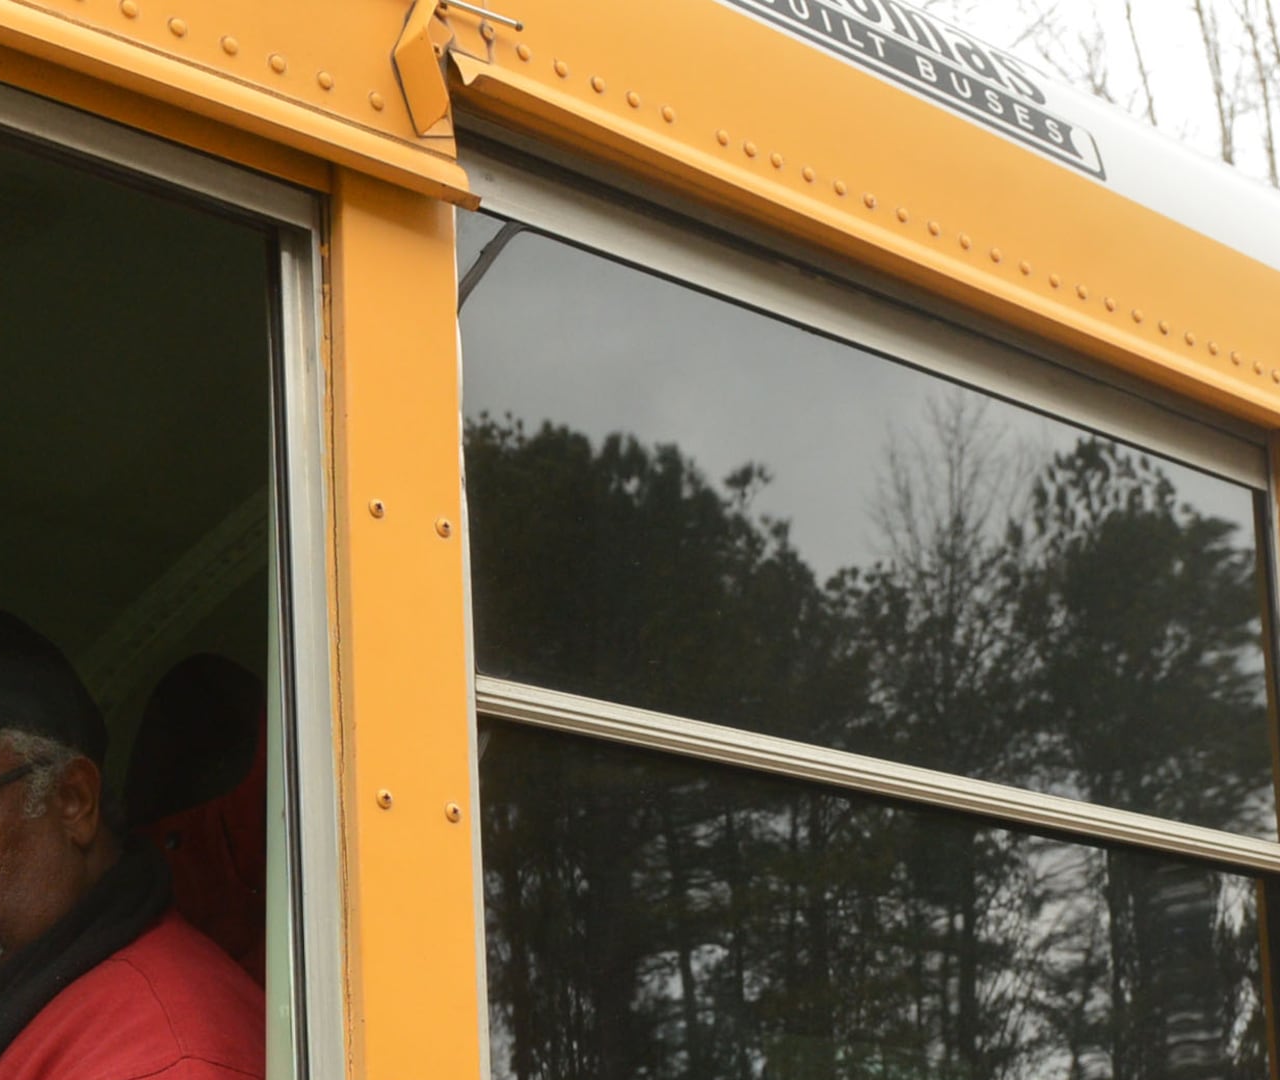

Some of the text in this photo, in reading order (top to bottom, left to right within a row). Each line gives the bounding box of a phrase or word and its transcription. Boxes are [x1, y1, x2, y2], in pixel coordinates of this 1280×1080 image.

[765, 0, 1063, 144] UILT BUSES
[826, 0, 1046, 105] omas
